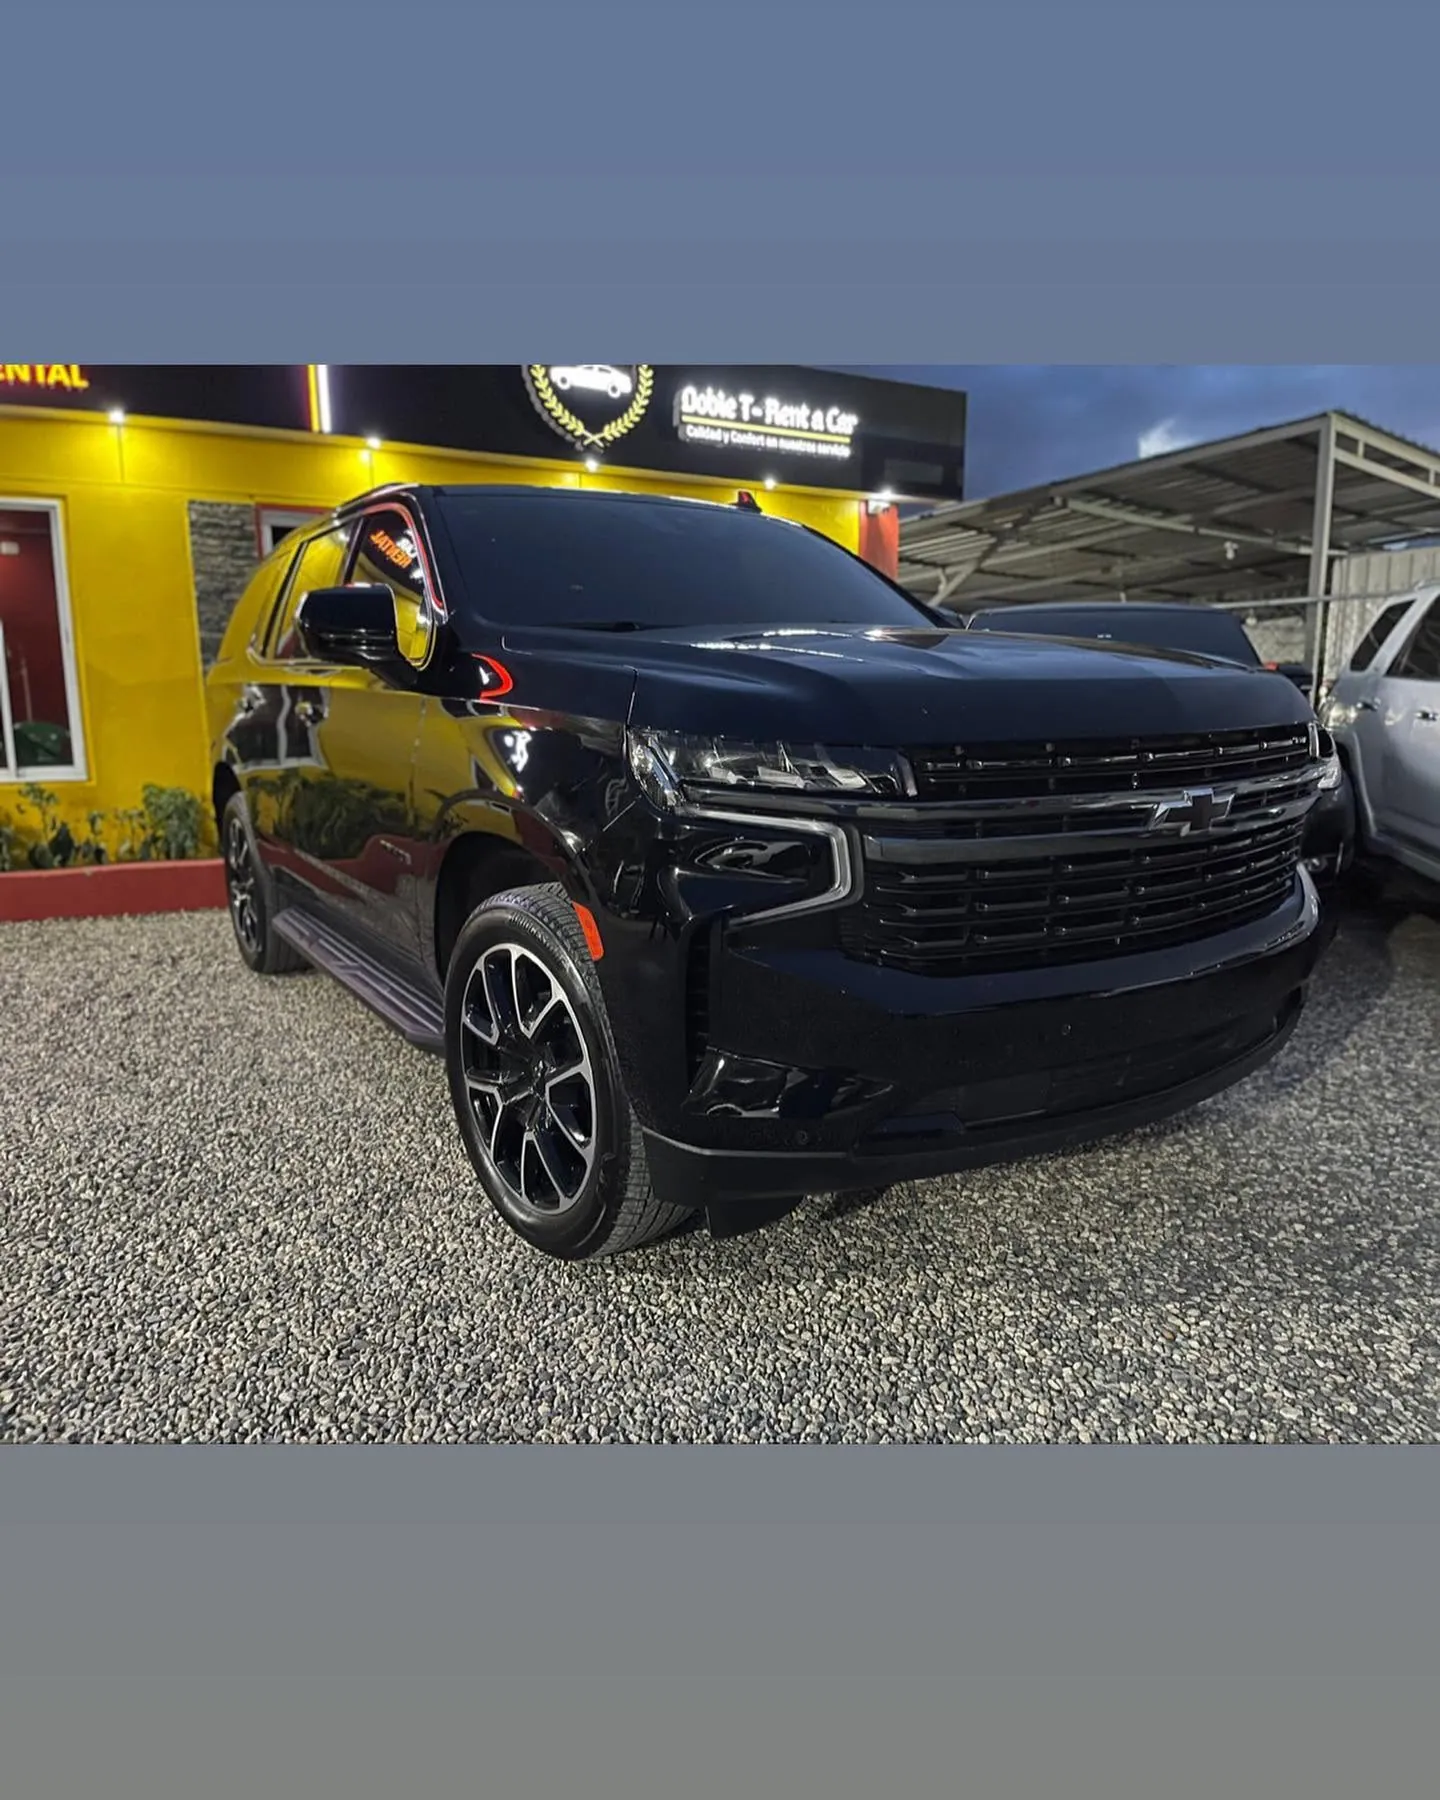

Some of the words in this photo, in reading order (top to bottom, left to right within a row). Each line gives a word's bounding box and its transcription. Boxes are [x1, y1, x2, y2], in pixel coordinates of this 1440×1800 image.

[0, 364, 89, 388] NTAL
[681, 385, 736, 419] Doble
[764, 396, 809, 430] Rent
[811, 407, 824, 431] a
[826, 406, 858, 435] Car
[686, 424, 721, 441] Calidad
[722, 431, 729, 444] y
[730, 430, 764, 447] Confort
